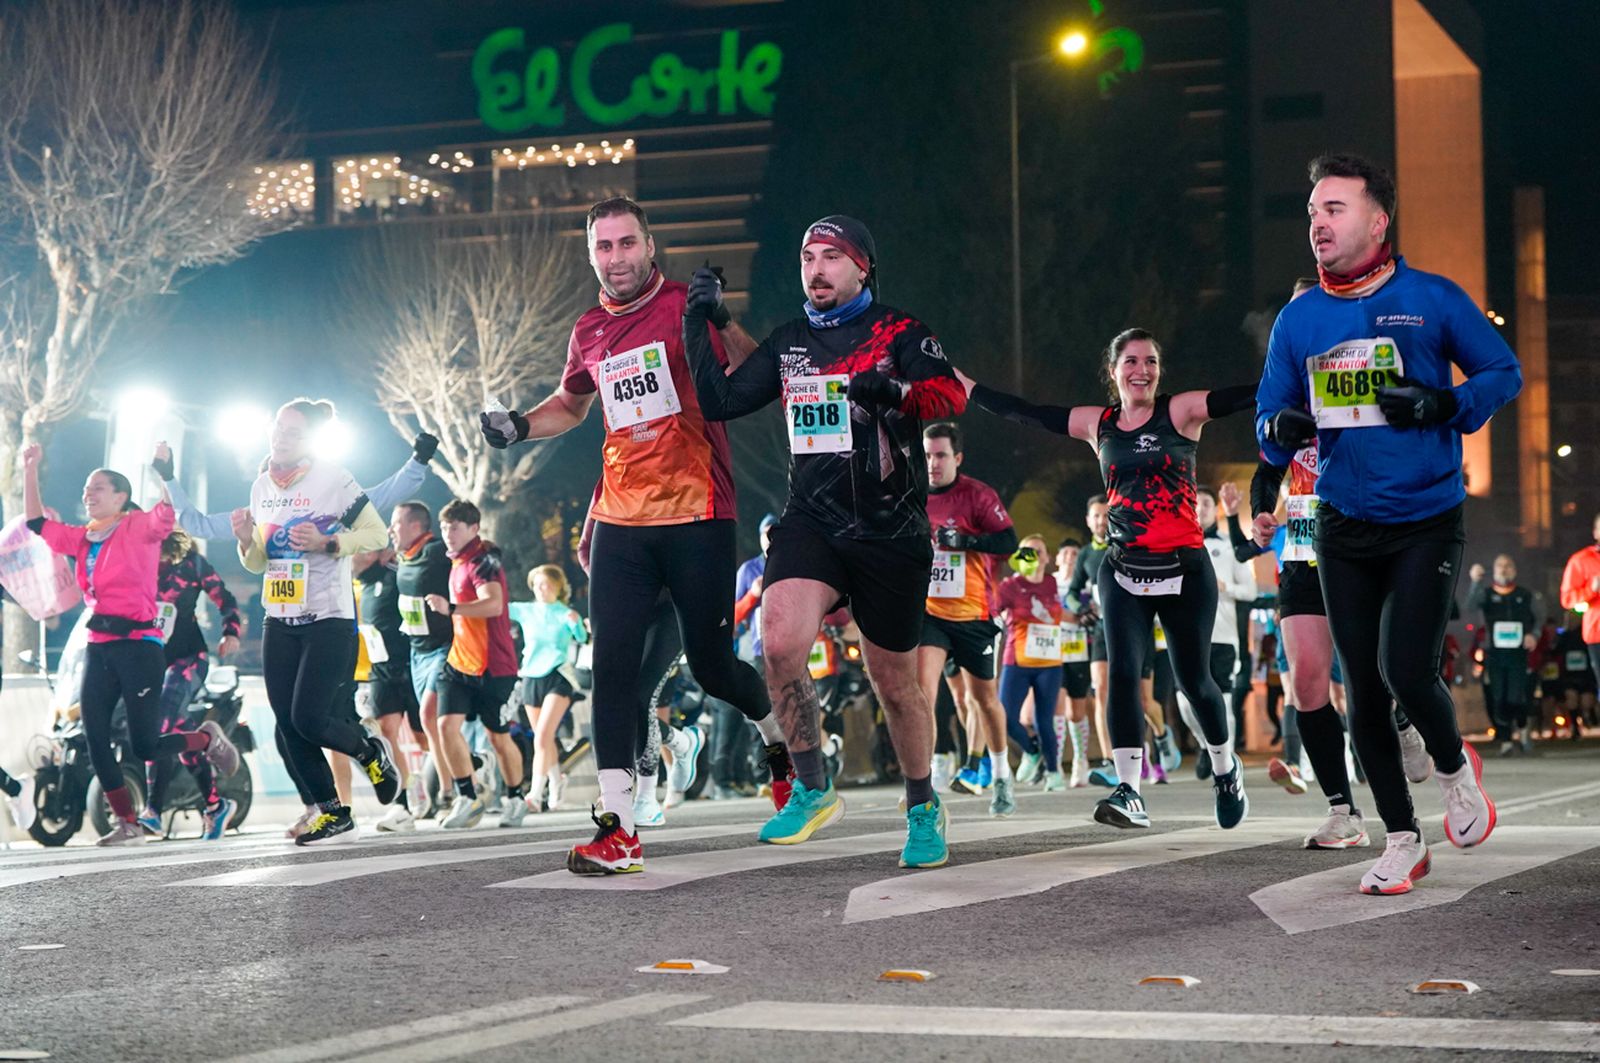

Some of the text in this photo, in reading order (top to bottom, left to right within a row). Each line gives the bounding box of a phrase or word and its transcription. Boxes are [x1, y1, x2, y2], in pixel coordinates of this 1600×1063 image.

[471, 22, 784, 133] El Corte
[1328, 349, 1355, 359] NOCHE
[612, 358, 630, 371] NOCHE
[1319, 360, 1336, 371] SAN
[605, 371, 619, 383] SAN
[1326, 370, 1386, 398] 4689
[613, 371, 659, 403] 4358
[788, 384, 818, 393] OCHE DE
[791, 403, 840, 428] 2618
[271, 580, 296, 598] 1149
